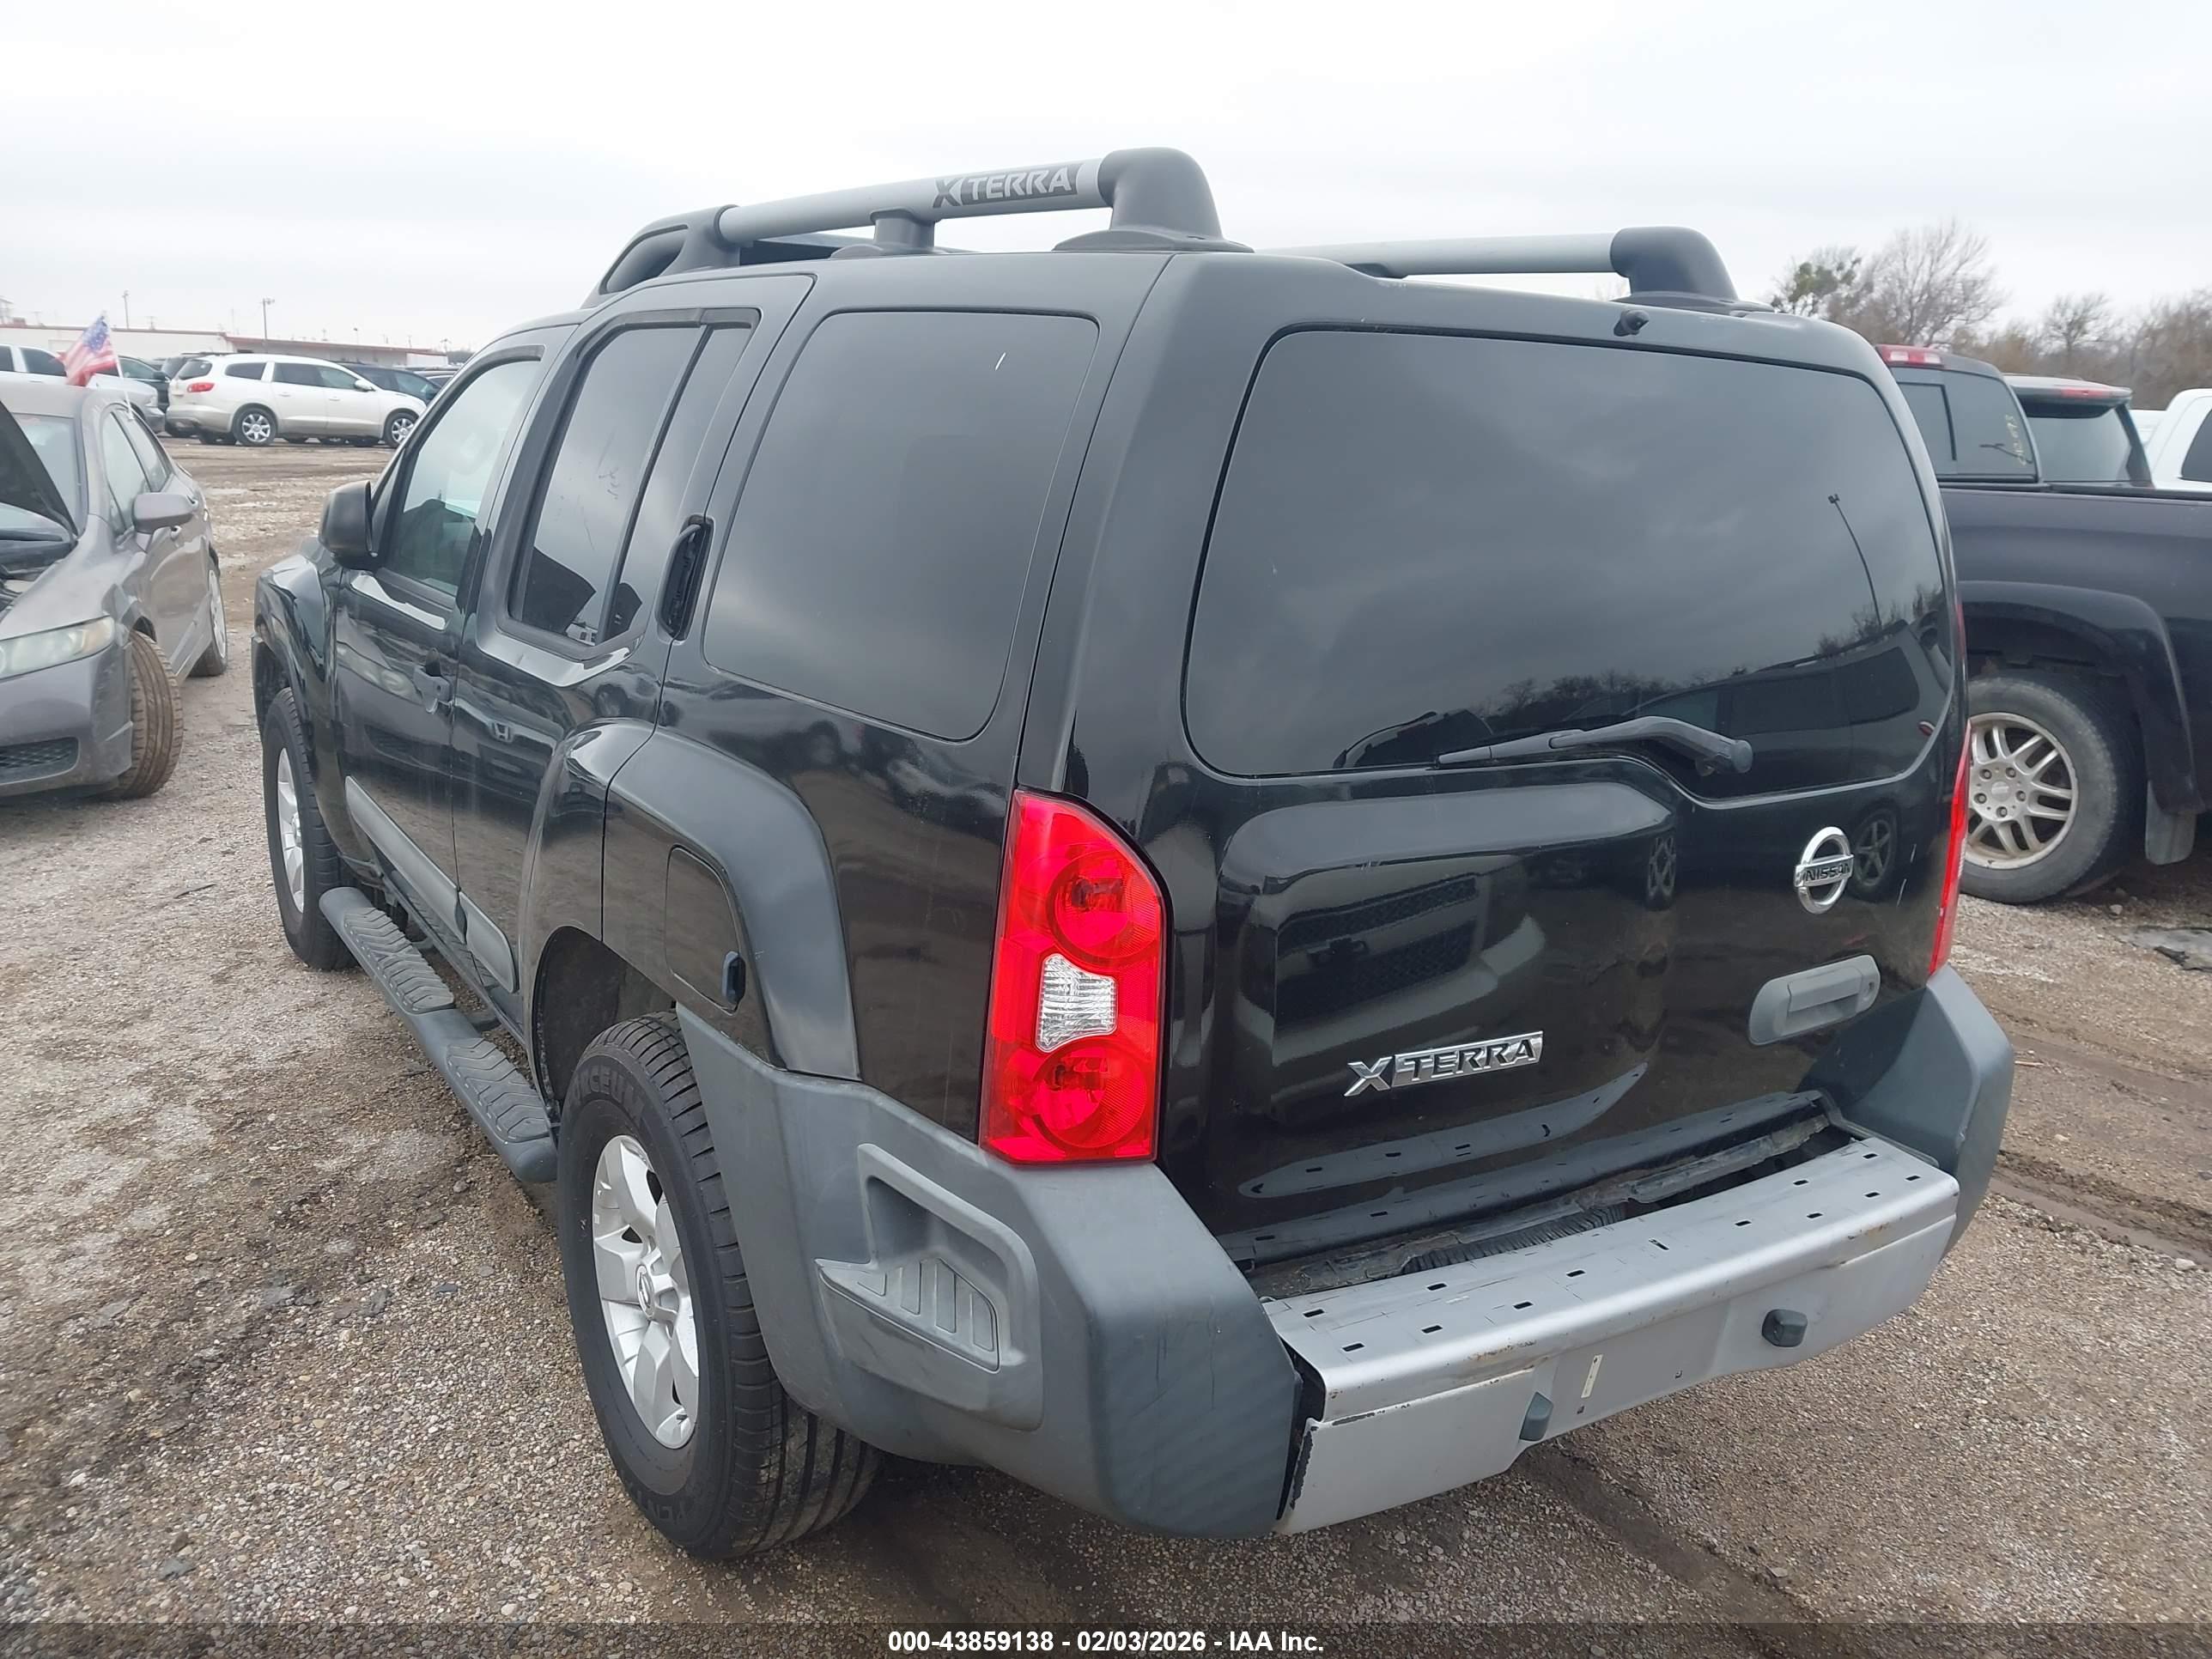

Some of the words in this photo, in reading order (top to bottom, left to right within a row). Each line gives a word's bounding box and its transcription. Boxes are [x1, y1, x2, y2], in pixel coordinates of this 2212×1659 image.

[933, 167, 1073, 208] XTERRA
[1805, 862, 1850, 882] NISSAN
[1344, 1032, 1541, 1097] XTERRA
